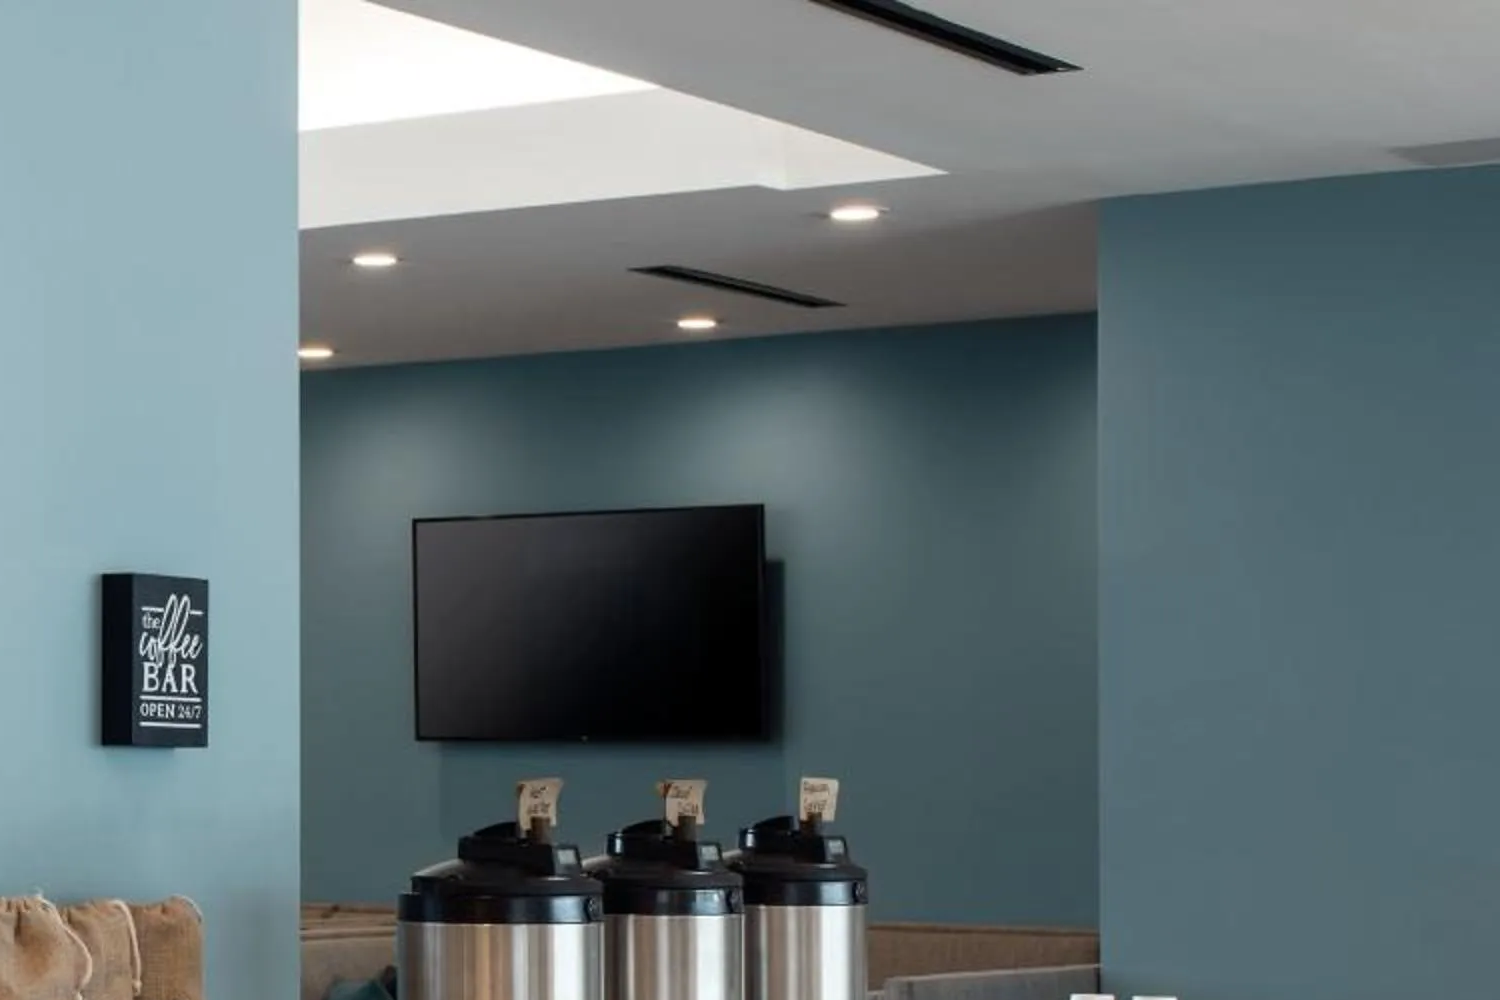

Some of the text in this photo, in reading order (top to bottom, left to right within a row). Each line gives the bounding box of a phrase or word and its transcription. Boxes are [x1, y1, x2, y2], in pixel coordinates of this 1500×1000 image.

[139, 593, 203, 668] coffee
[142, 612, 161, 629] the
[142, 661, 199, 694] BAR
[139, 703, 202, 719] OPEN 24/7
